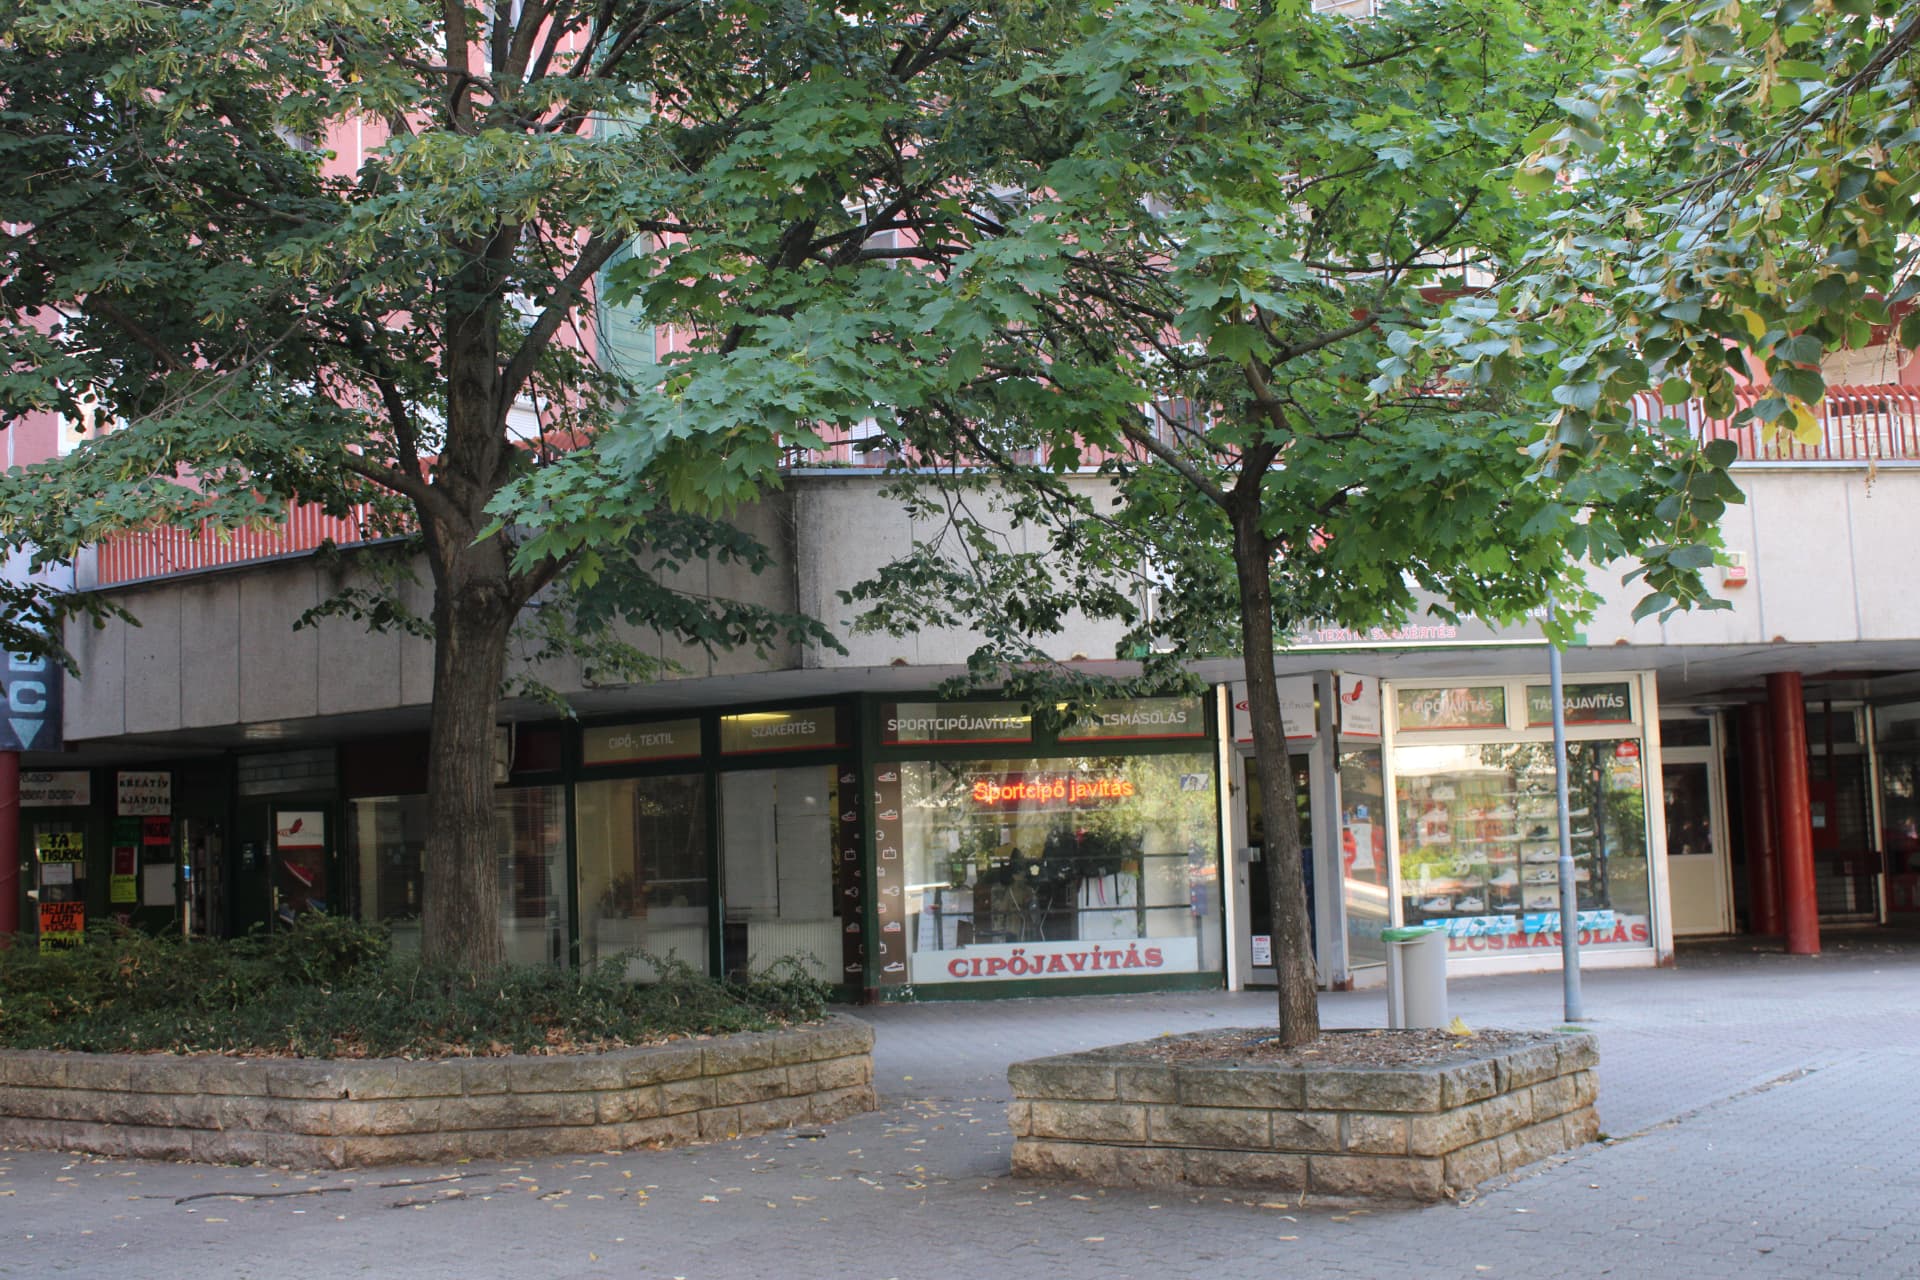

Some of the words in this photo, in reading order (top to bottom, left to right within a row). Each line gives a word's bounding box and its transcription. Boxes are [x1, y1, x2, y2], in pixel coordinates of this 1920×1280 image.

[1412, 696, 1494, 713] CIPŐJAVÍTÁS
[1533, 693, 1625, 710] TÁSAJAVÍTÁS
[887, 714, 1024, 731] SPORTCIPŐJAVÍTÁS
[1076, 711, 1187, 726] CSMÁSOLÁS
[640, 732, 674, 747] TEXTIL
[1069, 778, 1134, 803] javítás
[947, 942, 1164, 978] CIPŐJAVÍTÁS
